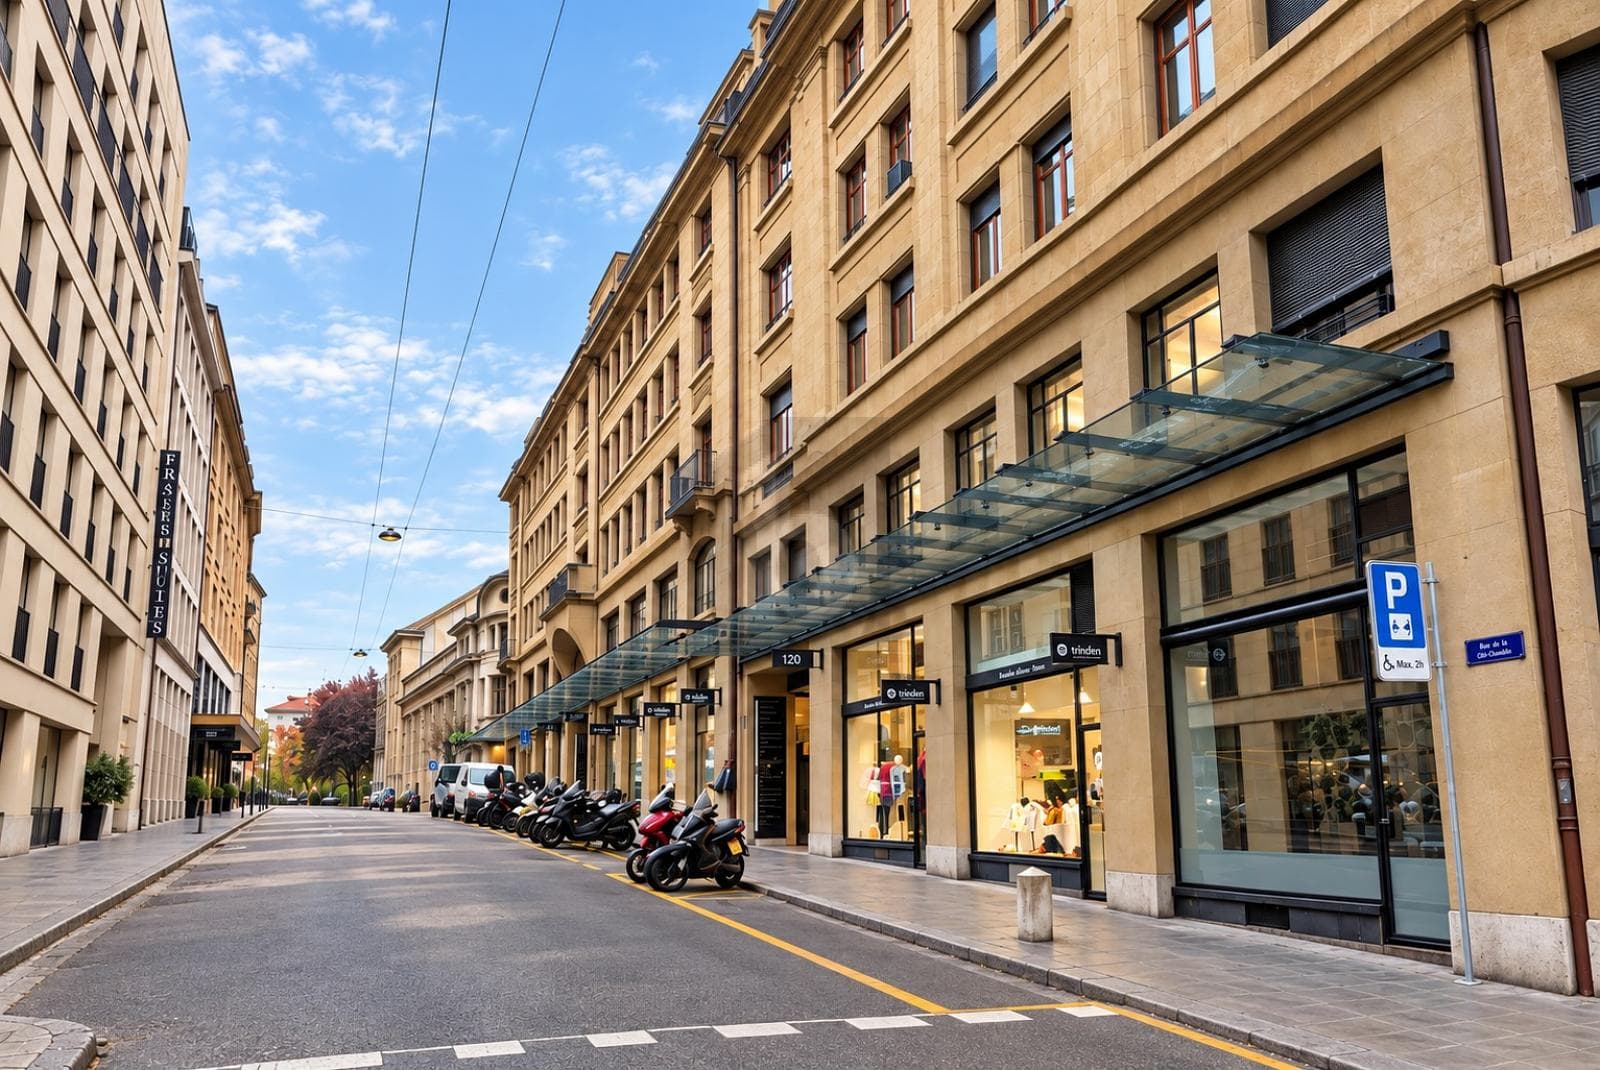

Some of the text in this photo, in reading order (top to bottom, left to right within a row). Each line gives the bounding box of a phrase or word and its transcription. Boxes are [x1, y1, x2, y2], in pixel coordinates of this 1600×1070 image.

[1384, 571, 1408, 609] P
[782, 654, 802, 665] 120
[1396, 660, 1425, 669] Max. 2h
